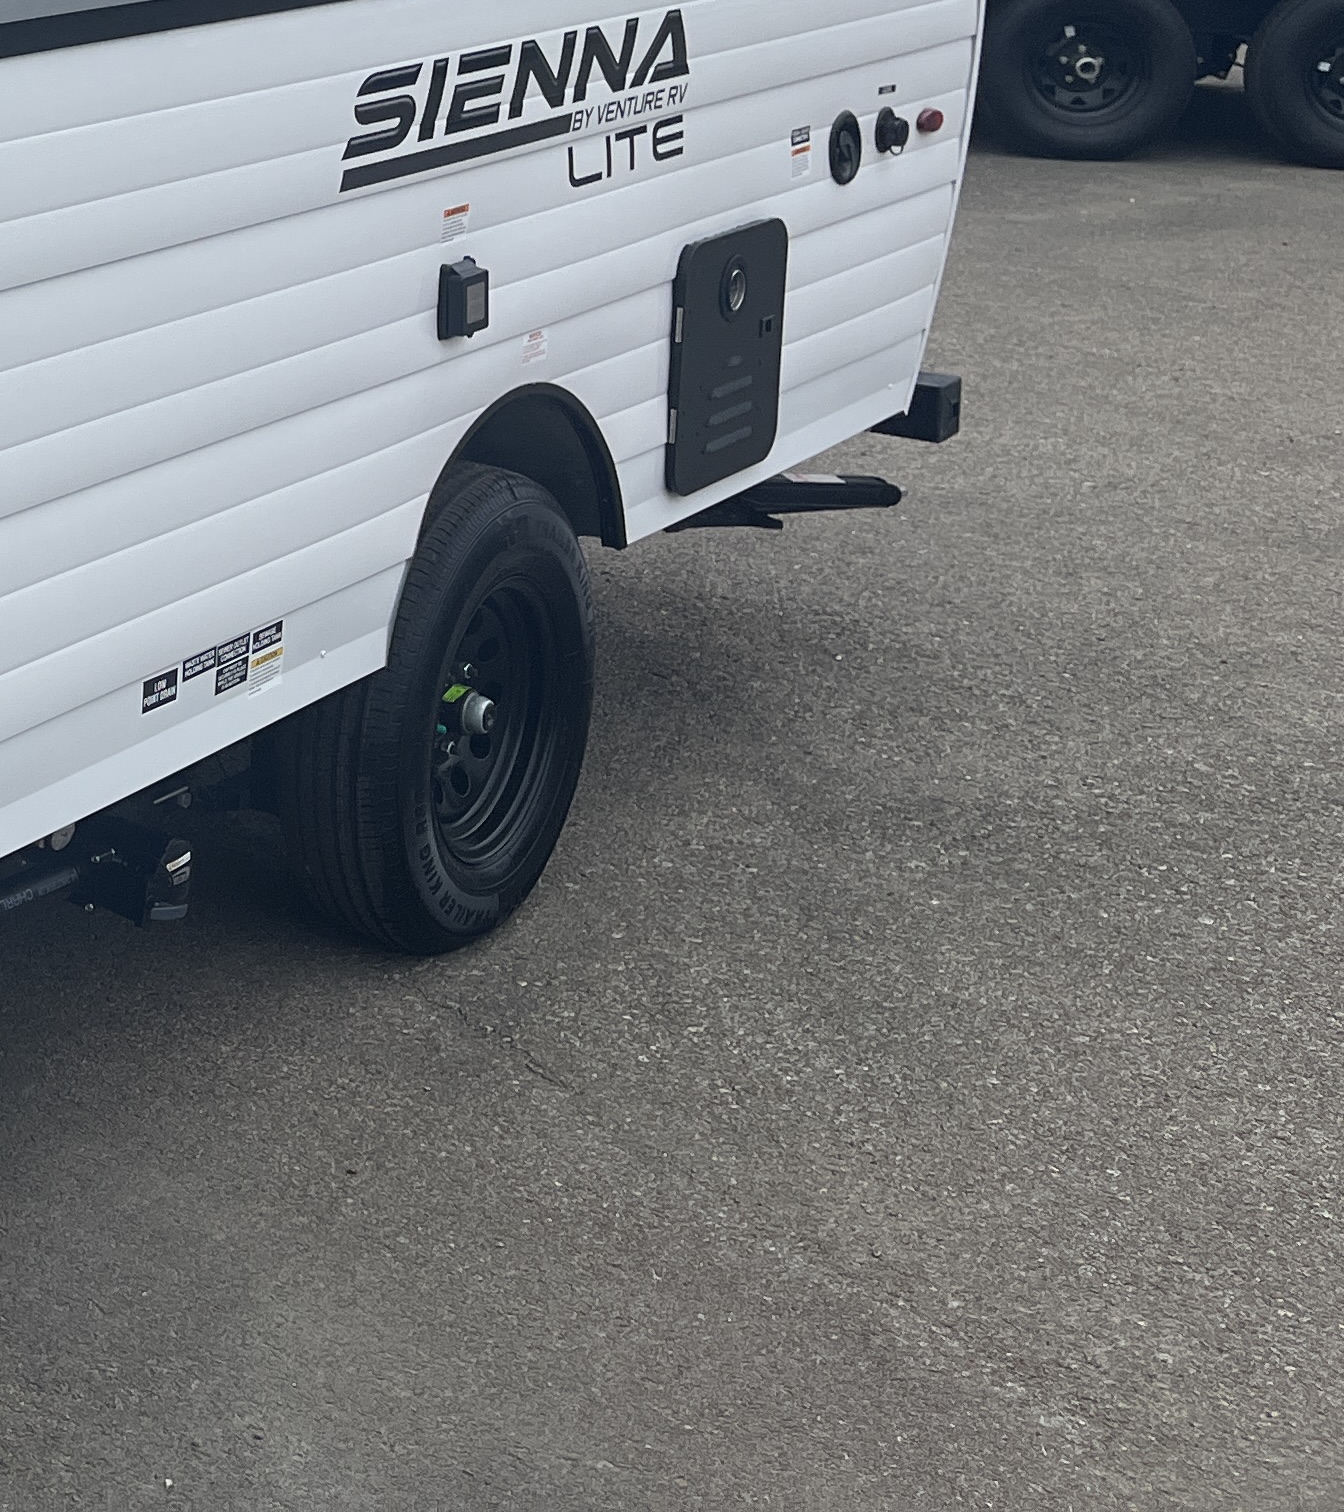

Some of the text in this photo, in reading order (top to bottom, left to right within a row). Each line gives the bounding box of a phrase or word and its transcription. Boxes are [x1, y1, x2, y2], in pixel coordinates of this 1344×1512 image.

[341, 9, 690, 161] SIENNA
[572, 83, 688, 132] BY VENTURE RV
[568, 114, 684, 188] LITE
[419, 843, 443, 896] KING
